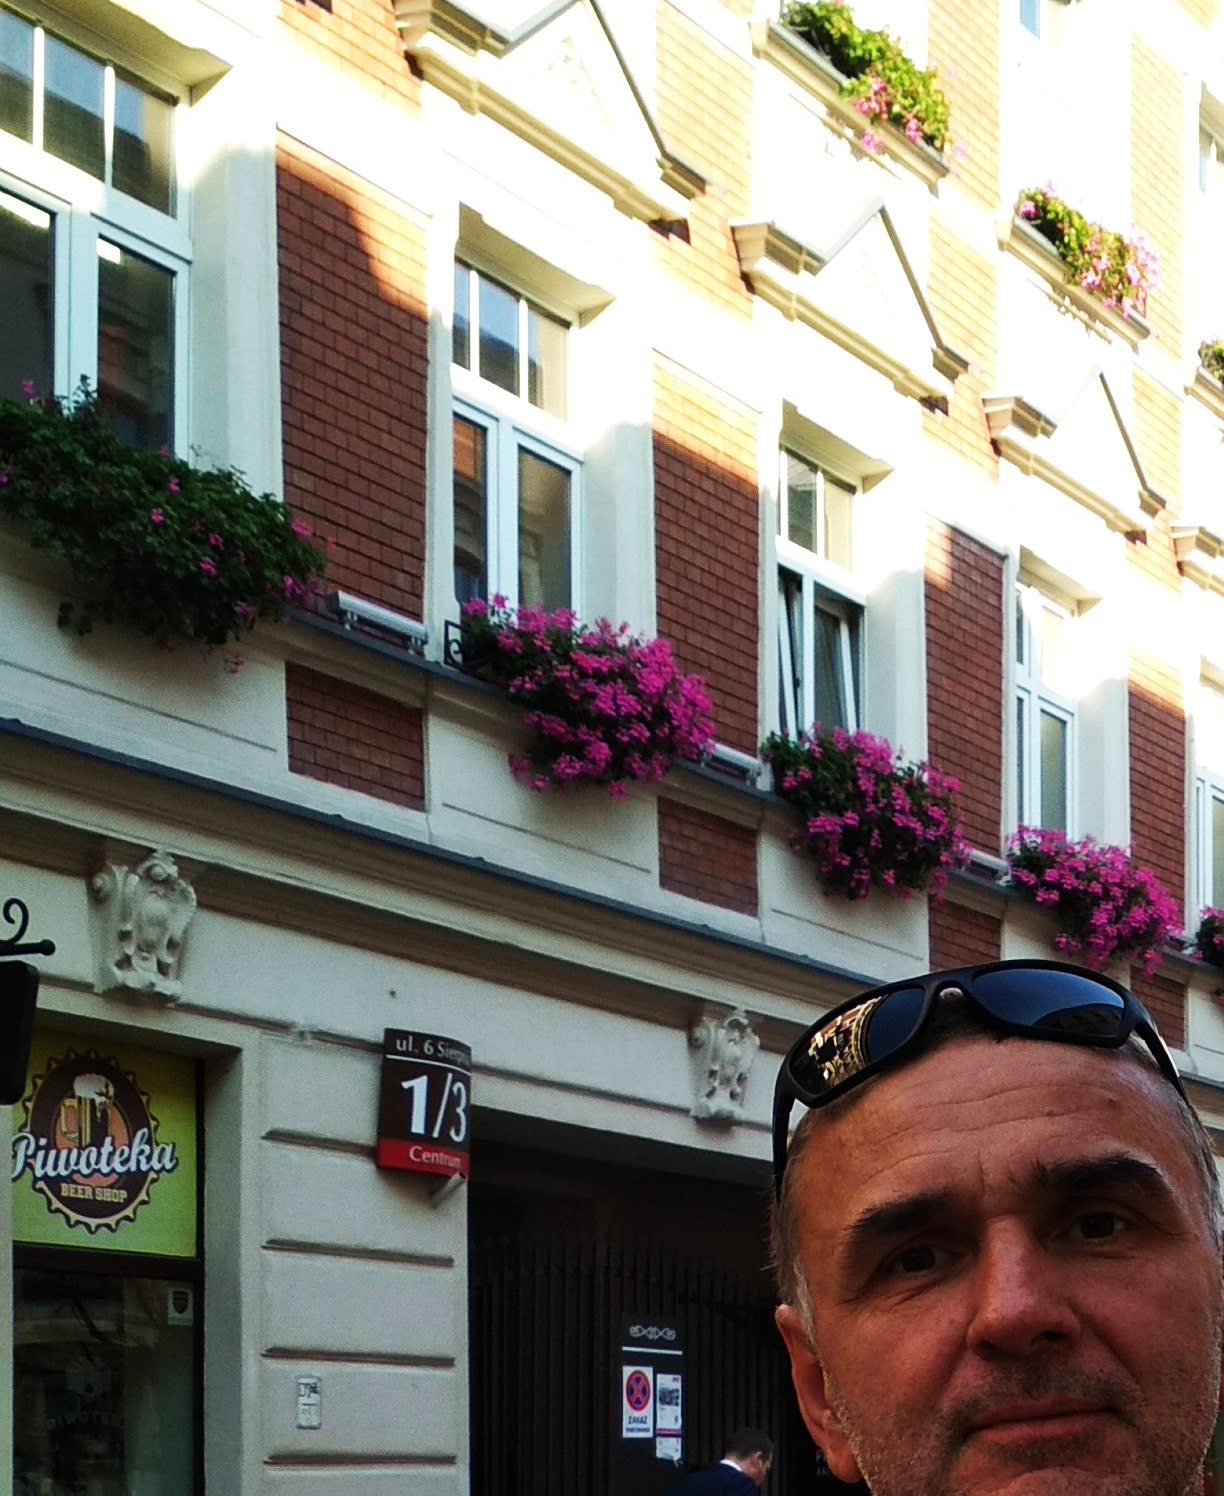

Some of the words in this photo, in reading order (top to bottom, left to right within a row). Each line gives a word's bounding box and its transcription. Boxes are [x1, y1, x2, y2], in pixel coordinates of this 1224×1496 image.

[395, 1035, 418, 1052] ul.
[423, 1039, 434, 1055] 6
[400, 1073, 467, 1142] 1/3
[11, 1127, 177, 1182] Piwoteka
[409, 1144, 462, 1168] Centrum
[60, 1182, 93, 1200] BEER
[95, 1185, 128, 1203] SHOP
[628, 1415, 648, 1425] ZAKAZ
